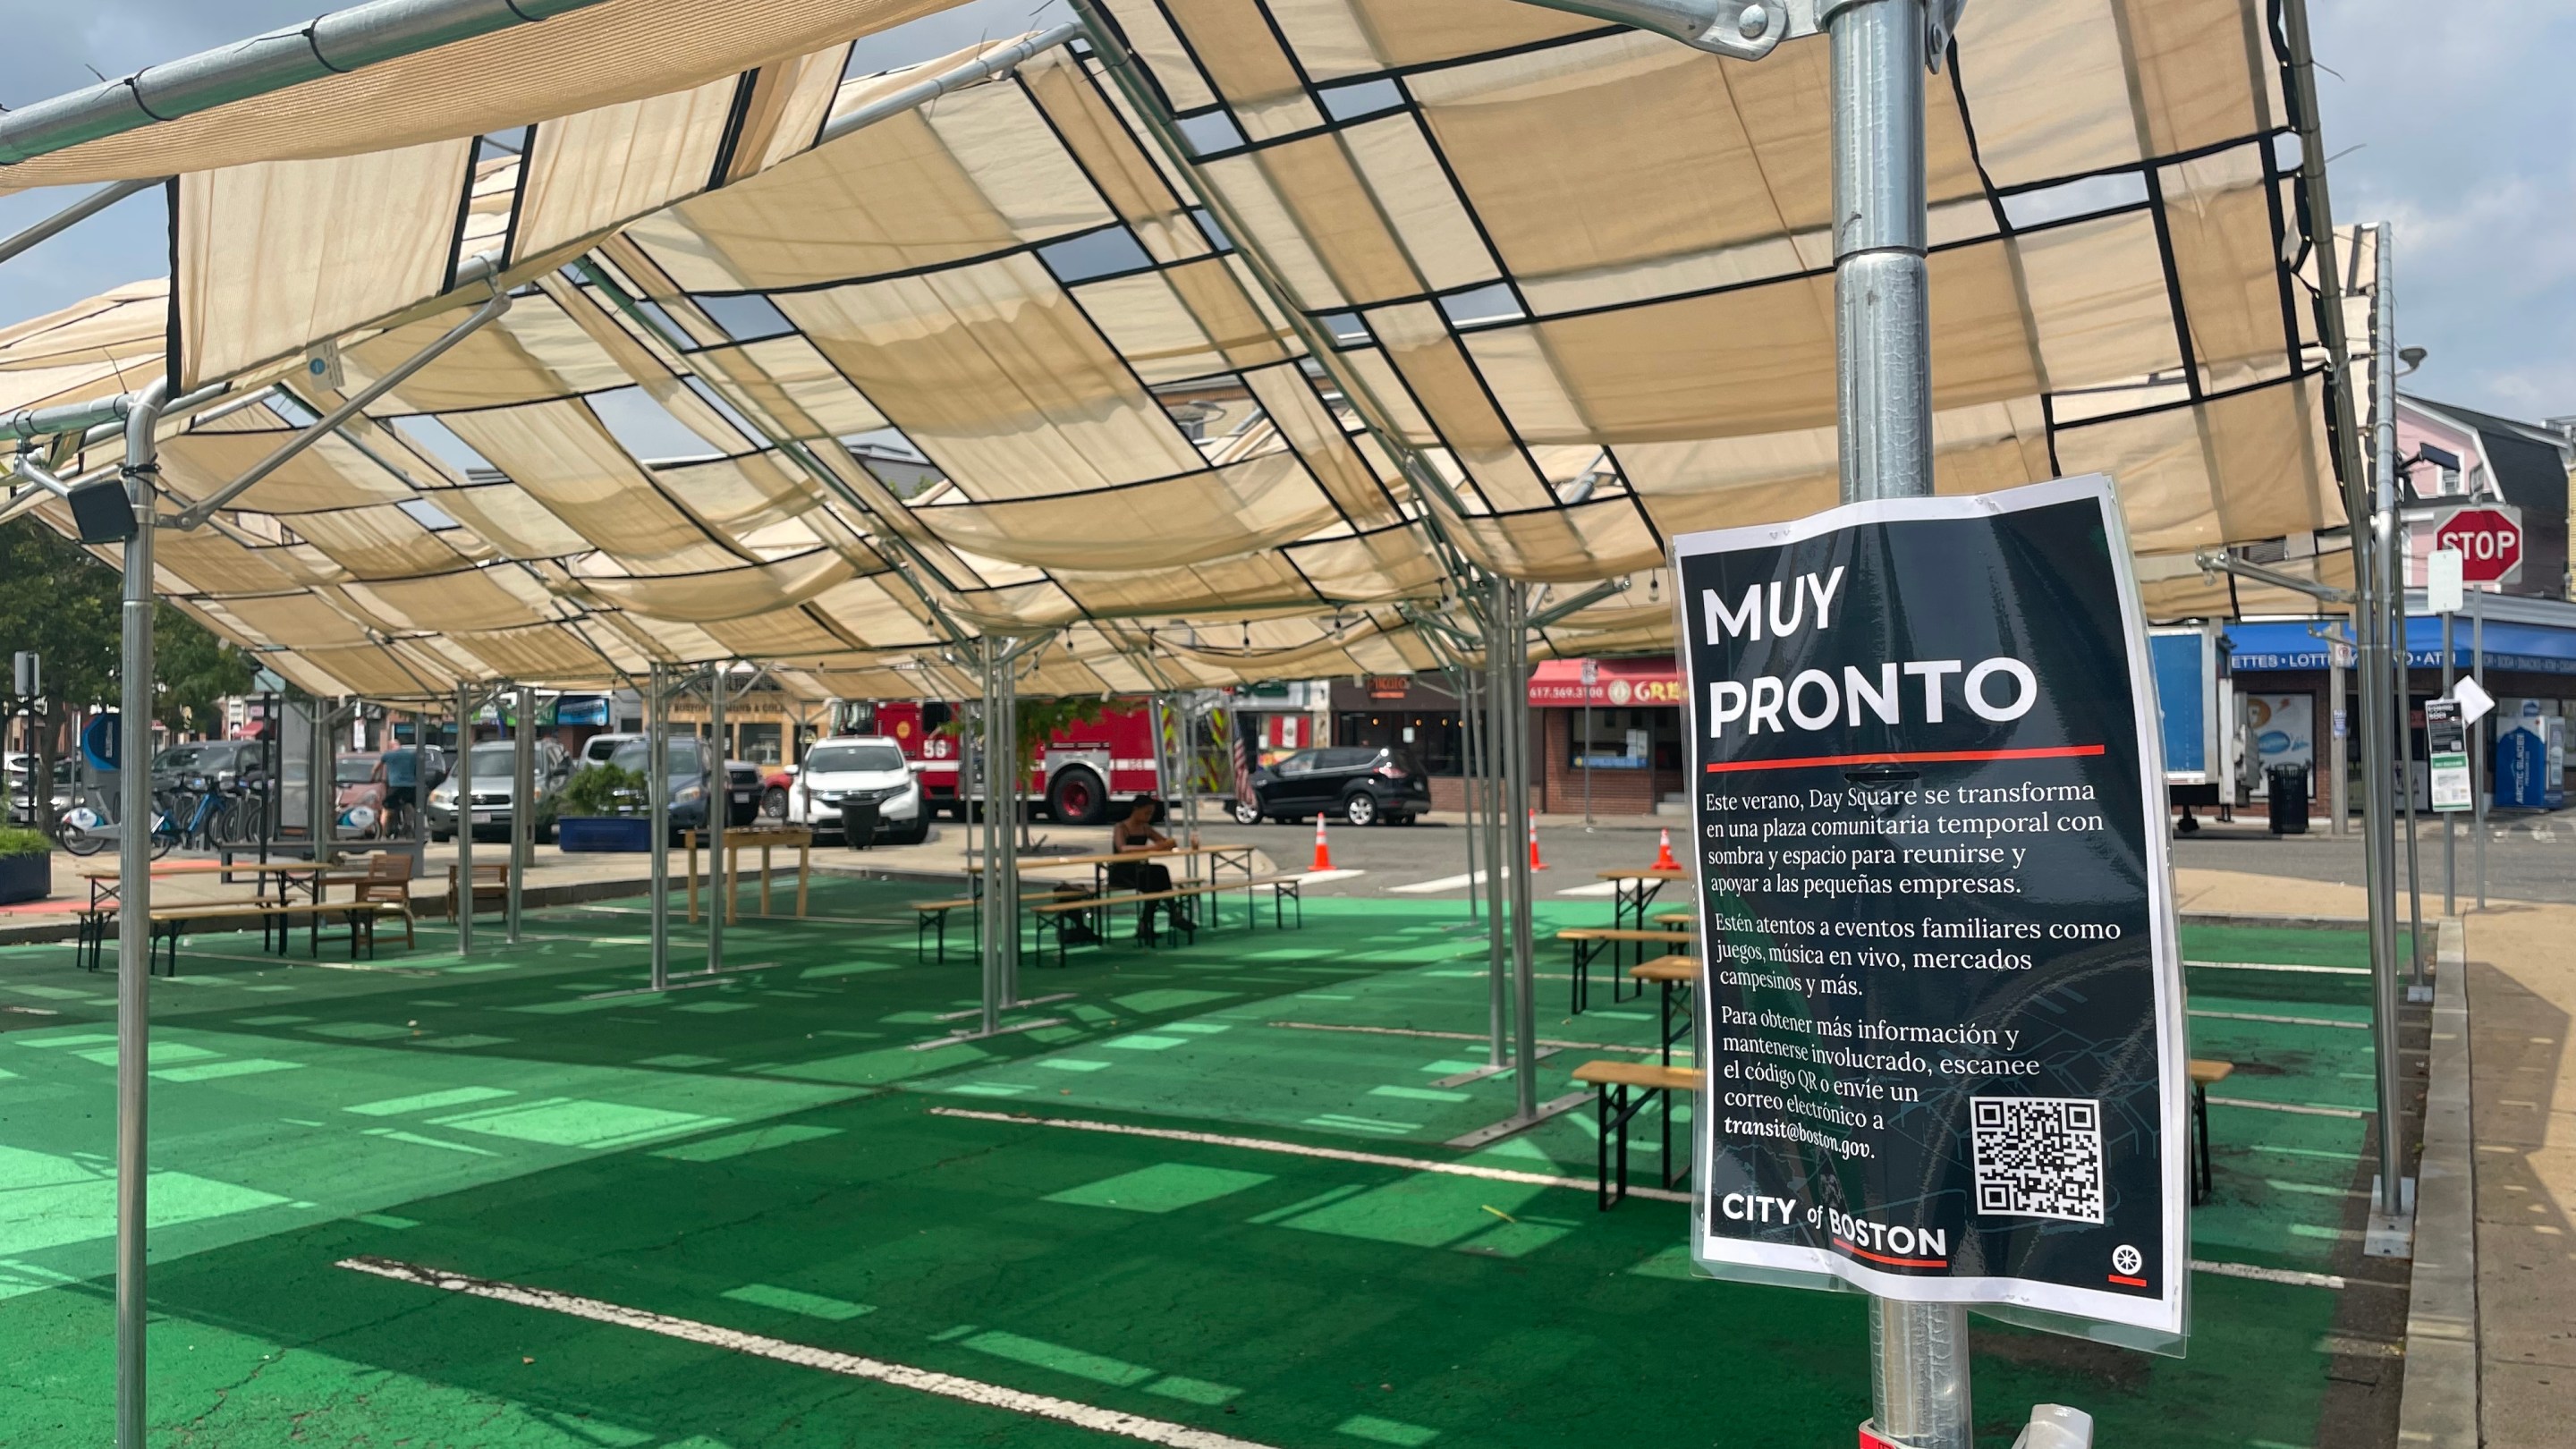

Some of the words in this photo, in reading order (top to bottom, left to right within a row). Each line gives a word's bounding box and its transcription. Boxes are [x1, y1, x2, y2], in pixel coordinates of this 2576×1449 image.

[2442, 530, 2516, 561] STOP
[1701, 565, 1845, 646] MUY
[1708, 657, 2038, 739] PRONTO
[923, 739, 946, 758] 56
[1706, 792, 1738, 811] Este
[1741, 793, 1804, 812] verano,
[1809, 789, 1843, 813] Day
[1847, 787, 1918, 811] Square
[1924, 789, 1950, 805] se
[1957, 781, 2096, 803] transforma
[1707, 823, 1724, 838] en
[1729, 821, 1758, 837] una
[1762, 818, 1807, 843] plaza
[1811, 815, 1930, 836] comunitaria
[1937, 811, 2049, 838] temporal
[2056, 815, 2104, 832] con
[1707, 846, 1764, 865] sombra
[1768, 850, 1778, 870] y
[1783, 845, 1846, 869] espacio
[1851, 848, 1896, 869] para
[1902, 843, 2004, 864] reunirse
[2012, 847, 2026, 869] y
[1711, 877, 1759, 897] apoyar
[1762, 879, 1772, 893] a
[1776, 873, 1799, 893] las
[1803, 874, 1893, 899] pequeñas
[1899, 877, 2021, 899] empresas.
[1715, 912, 1753, 932] Estén
[1756, 917, 1815, 936] atentos
[1819, 920, 1830, 936] a
[1835, 922, 1915, 938] eventos
[1921, 917, 2041, 939] familiares
[2049, 922, 2121, 939] como
[1716, 939, 1766, 964] juegos,
[1768, 943, 1824, 964] música
[1829, 950, 1852, 966] en
[1857, 946, 1907, 971] vivo,
[1912, 948, 2032, 970] mercados
[1720, 970, 1802, 992] campesinos
[1805, 978, 1817, 998] y
[1820, 973, 1863, 996] más.
[1721, 1005, 1757, 1026] Para
[1760, 1009, 1813, 1034] obtener
[1817, 1016, 1852, 1038] más
[1858, 1019, 1998, 1045] información
[2004, 1030, 2020, 1051] y
[1723, 1037, 1809, 1062] mantenerse
[1811, 1044, 1933, 1076] involucrado,
[1939, 1058, 2040, 1075] escanee
[1724, 1060, 1740, 1079] el
[1744, 1062, 1795, 1089] código
[1798, 1069, 1818, 1095] QR
[1820, 1079, 1829, 1093] o
[1834, 1078, 1884, 1099] envíe
[1889, 1086, 1919, 1103] un
[1724, 1090, 1784, 1111] correo
[1786, 1095, 1867, 1128] electrónico
[1872, 1114, 1885, 1130] a
[1724, 1116, 1876, 1160] transit@boston.gov.
[1722, 1192, 1797, 1224] CITY
[1807, 1205, 1823, 1230] of
[1828, 1207, 1947, 1257] BOSTON
